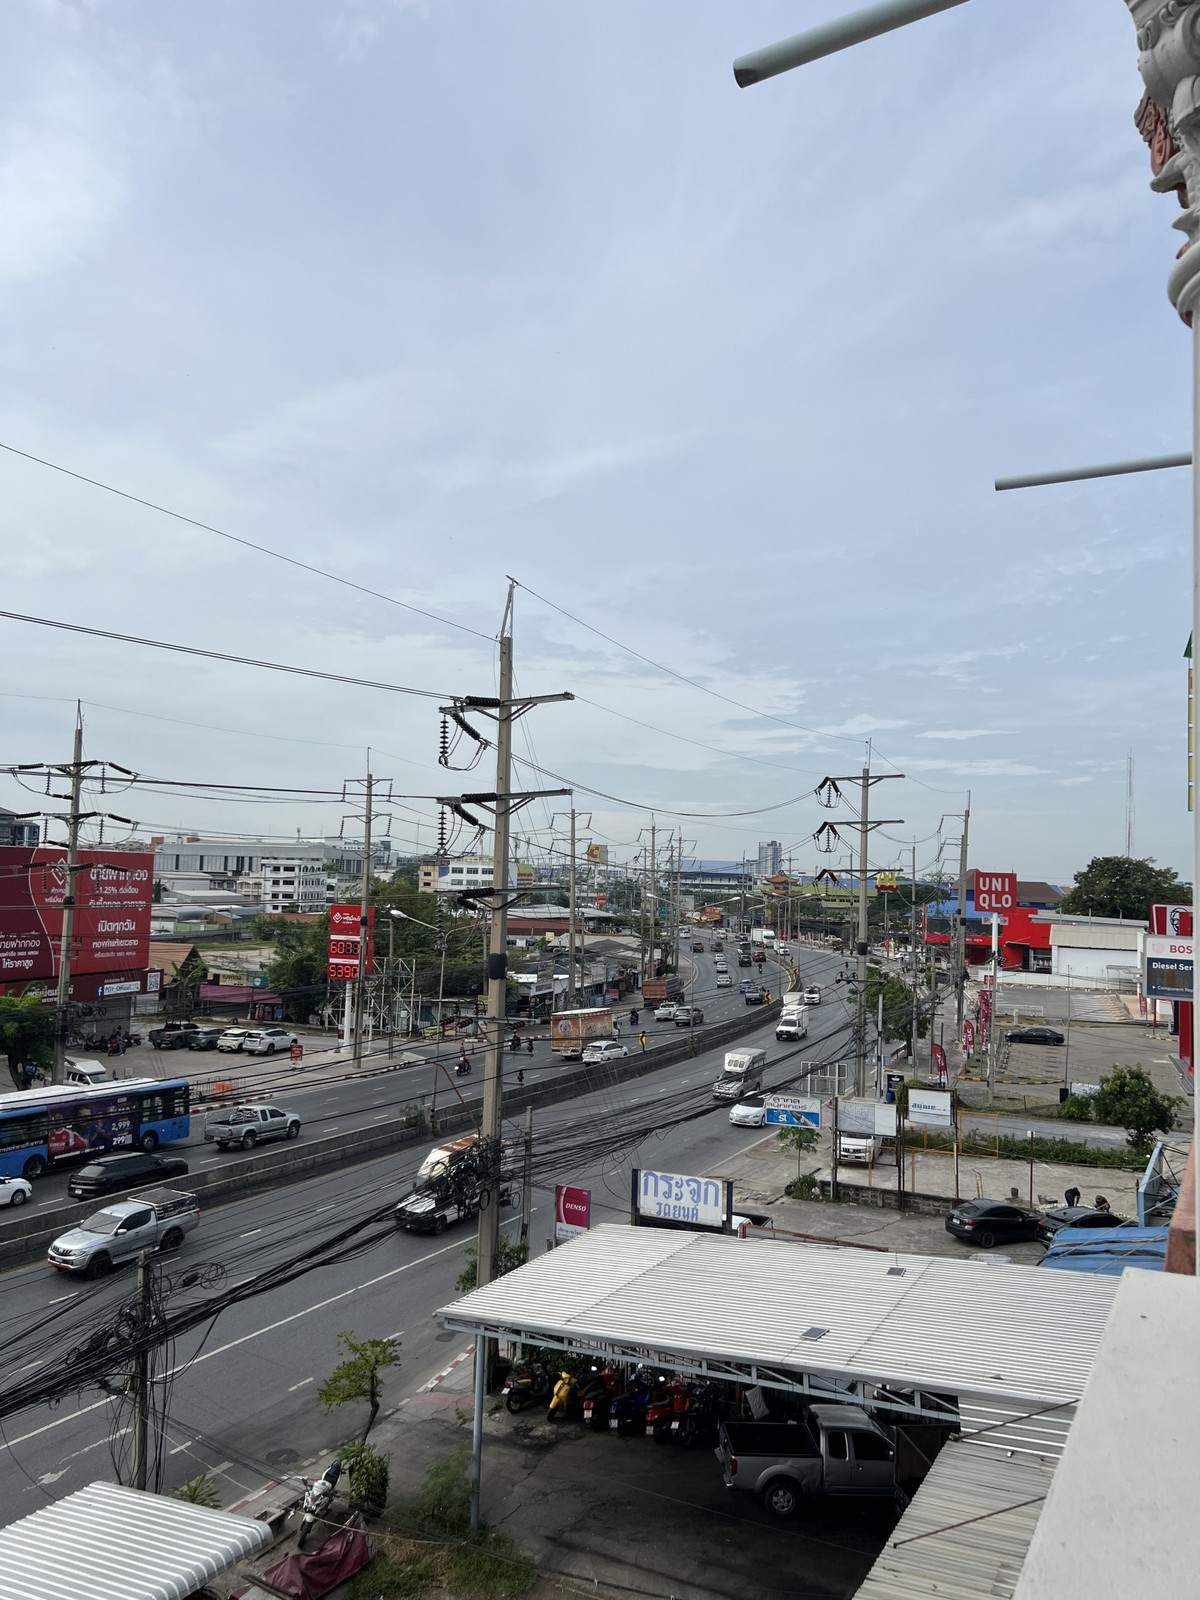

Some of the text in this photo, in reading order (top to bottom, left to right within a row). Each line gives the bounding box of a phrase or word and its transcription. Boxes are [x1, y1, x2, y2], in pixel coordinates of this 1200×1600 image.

[979, 877, 1009, 892] UNI
[979, 893, 1012, 910] QLO
[98, 919, 136, 934] เปิดทุกวัน
[1152, 962, 1177, 970] Diesel
[111, 1120, 131, 1131] 2,999
[112, 1136, 126, 1146] 299
[642, 1171, 719, 1207] กระจก
[565, 1202, 587, 1212] DENSO
